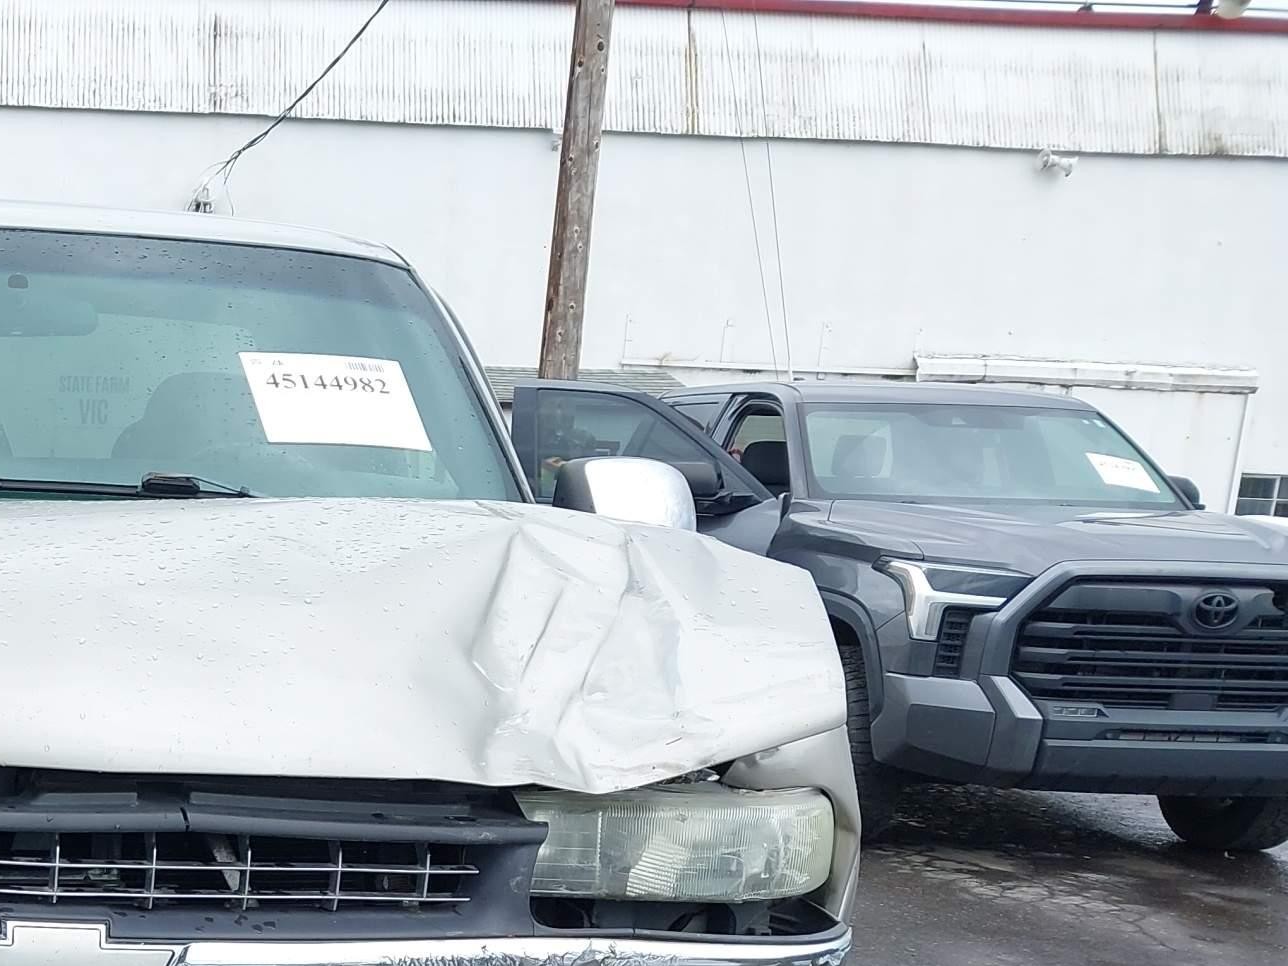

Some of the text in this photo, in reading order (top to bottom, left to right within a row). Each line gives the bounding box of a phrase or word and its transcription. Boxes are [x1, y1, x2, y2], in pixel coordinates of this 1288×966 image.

[59, 375, 93, 393] STATE
[265, 372, 391, 395] 45144982
[79, 399, 109, 425] VIC
